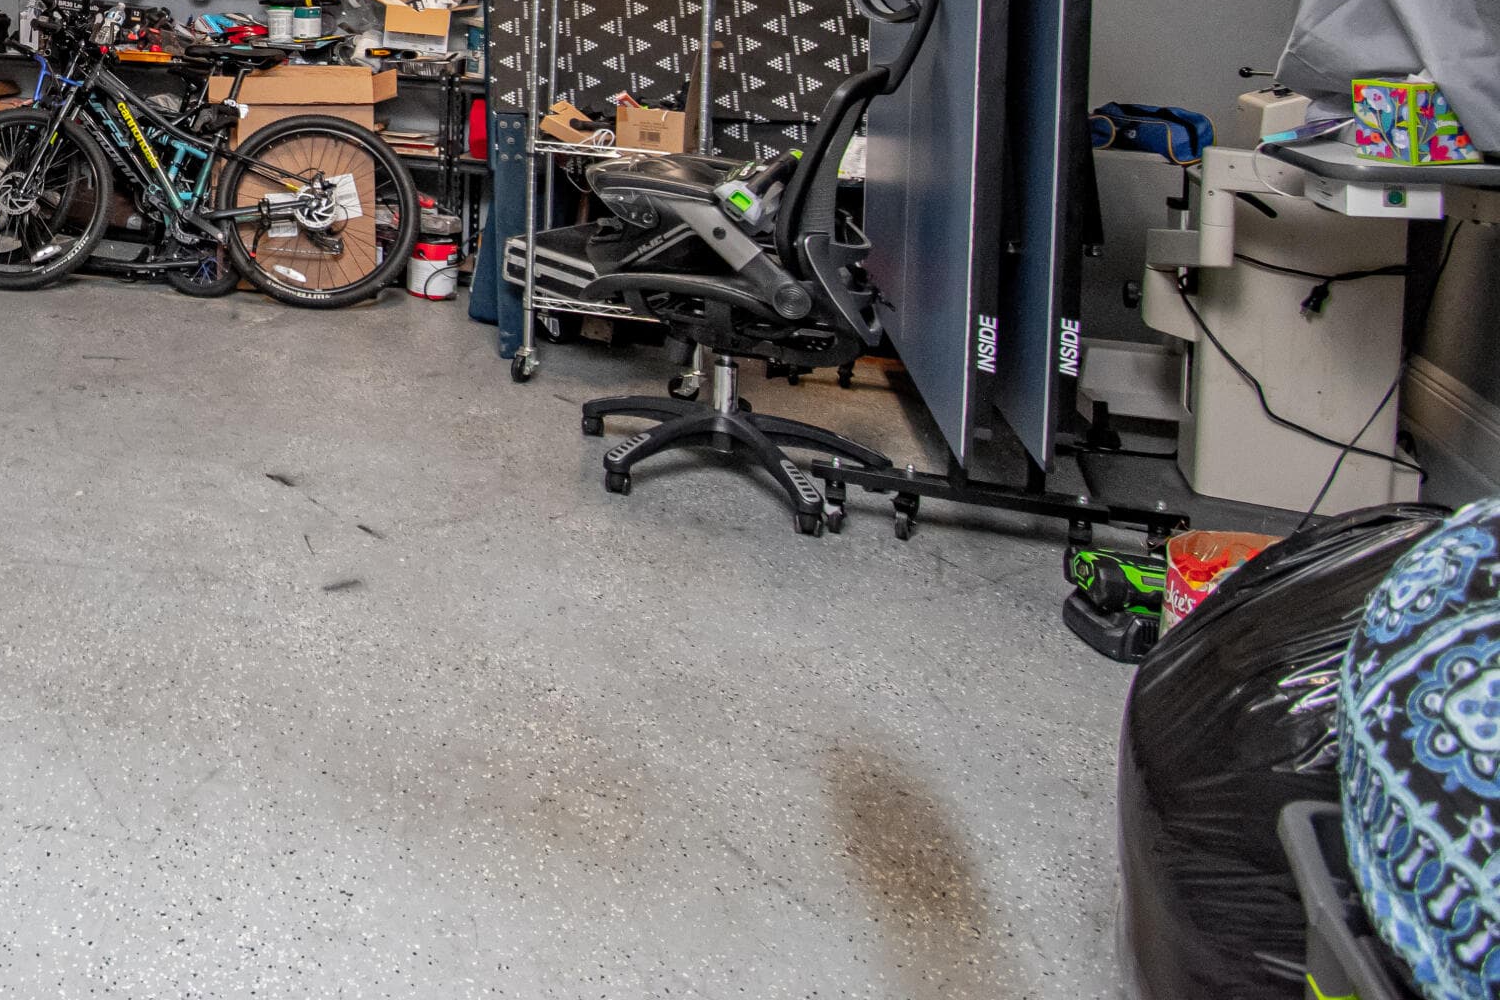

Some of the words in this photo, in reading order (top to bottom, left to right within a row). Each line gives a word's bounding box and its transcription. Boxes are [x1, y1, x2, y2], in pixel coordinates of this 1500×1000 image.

[117, 101, 159, 169] cannondale
[977, 314, 999, 374] INSIDE
[1059, 317, 1081, 377] INSIDE
